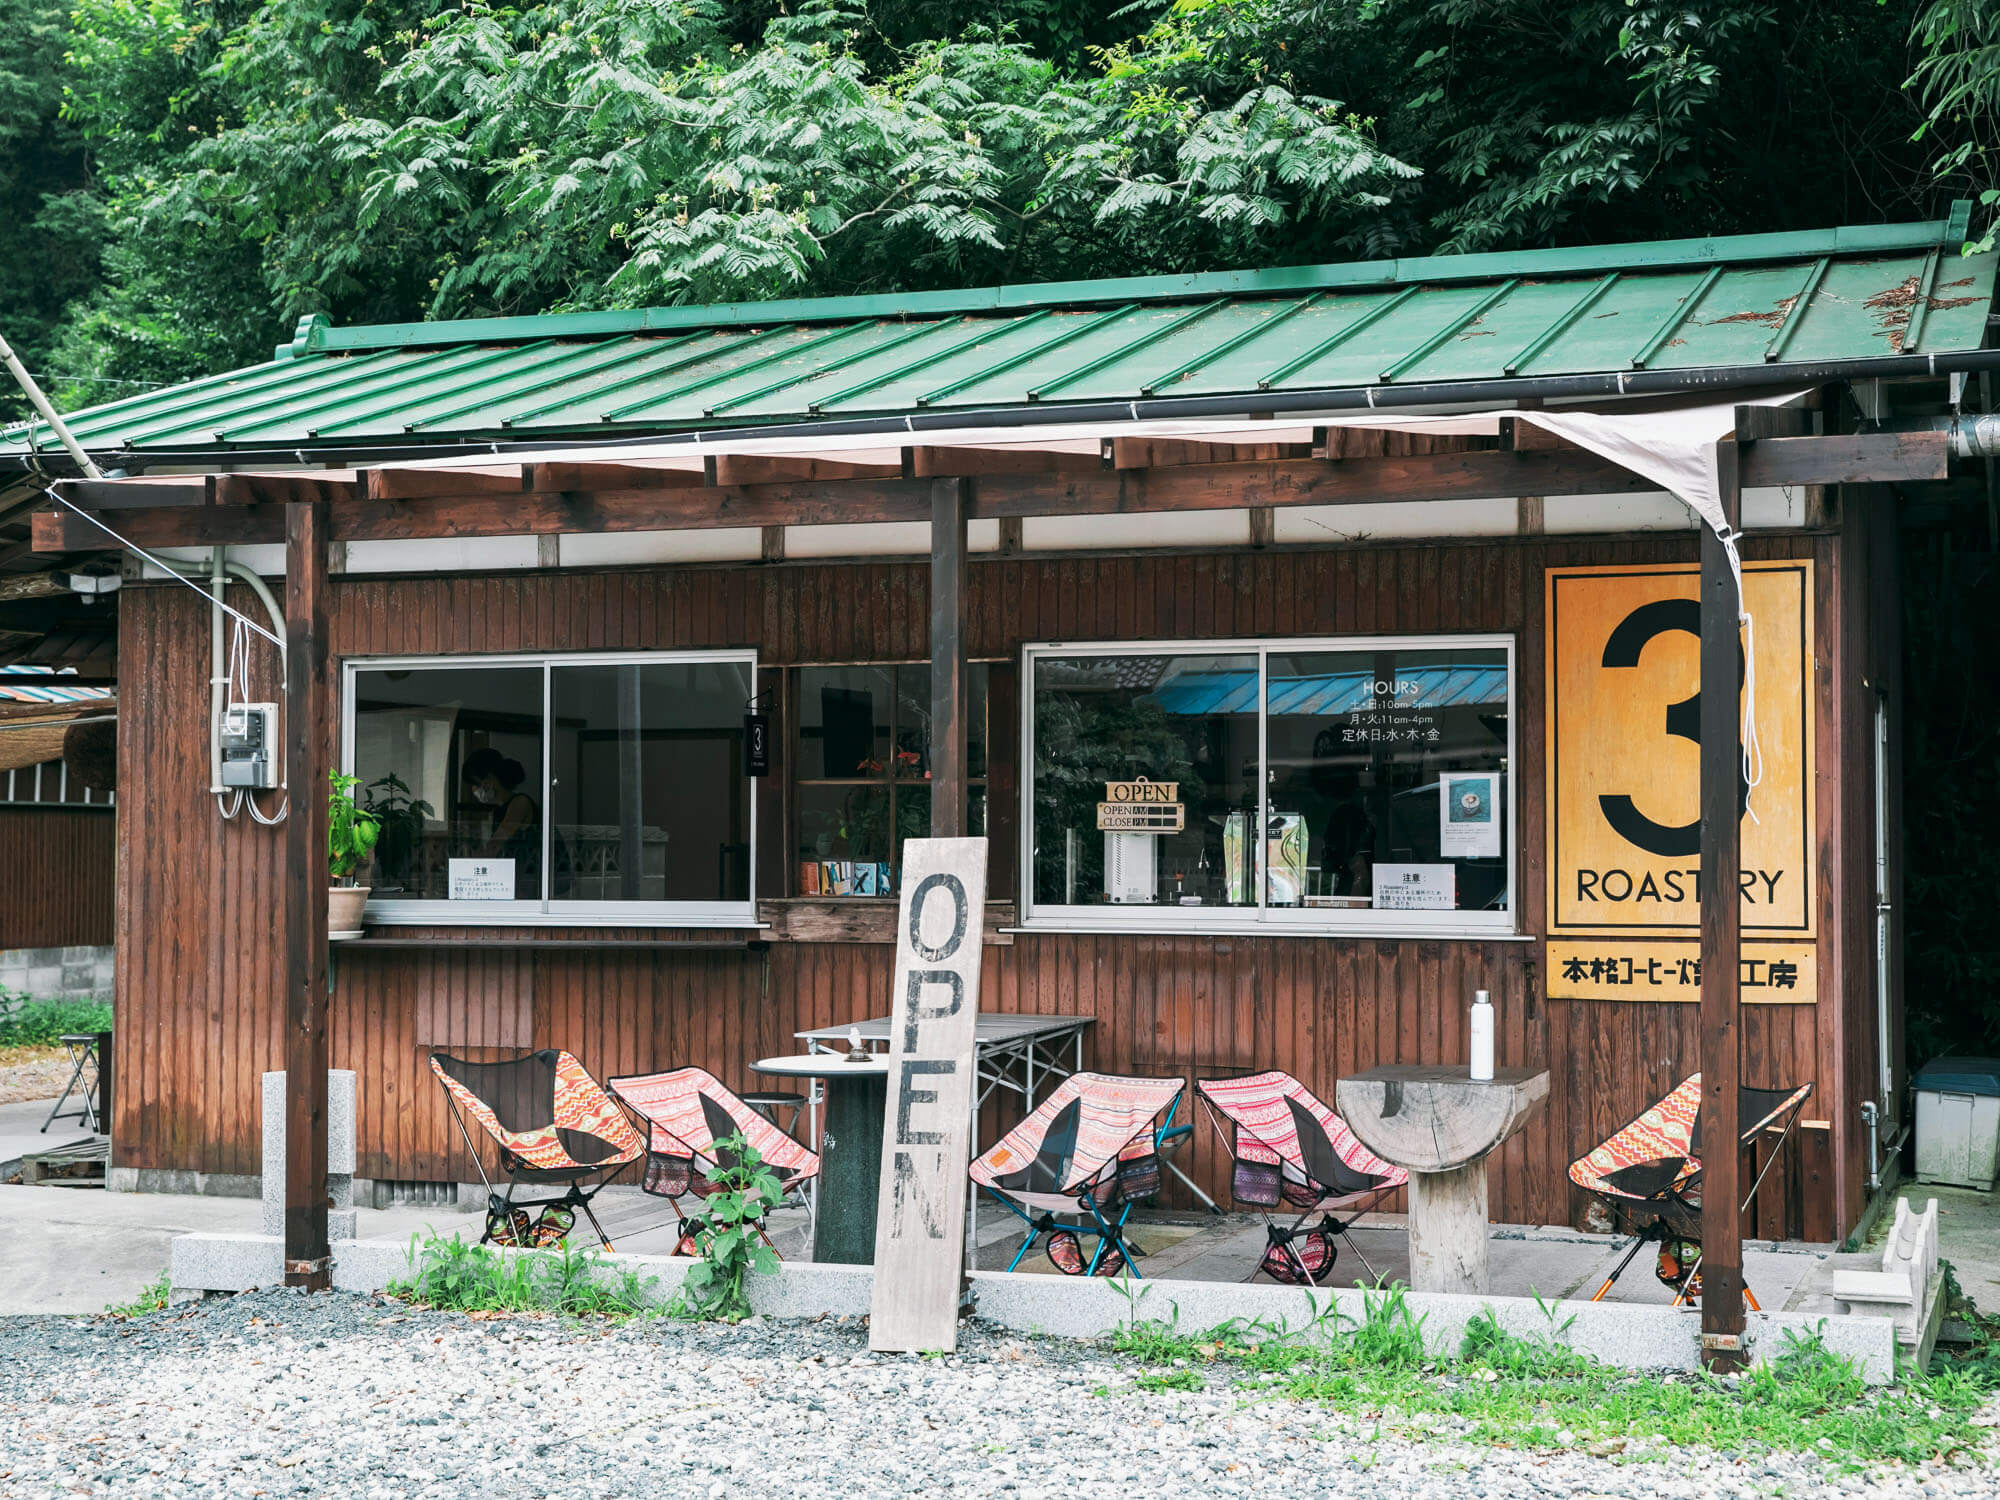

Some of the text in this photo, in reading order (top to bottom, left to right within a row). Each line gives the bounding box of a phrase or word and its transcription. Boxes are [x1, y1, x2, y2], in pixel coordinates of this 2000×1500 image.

[1363, 681, 1419, 695] HOURS
[1598, 598, 1749, 857] 3
[1114, 784, 1171, 801] OPEN
[1104, 805, 1131, 815] OPEN
[1104, 818, 1131, 827] CLOSE
[1577, 869, 1784, 905] ROASTRY
[891, 873, 968, 1240] OPEN
